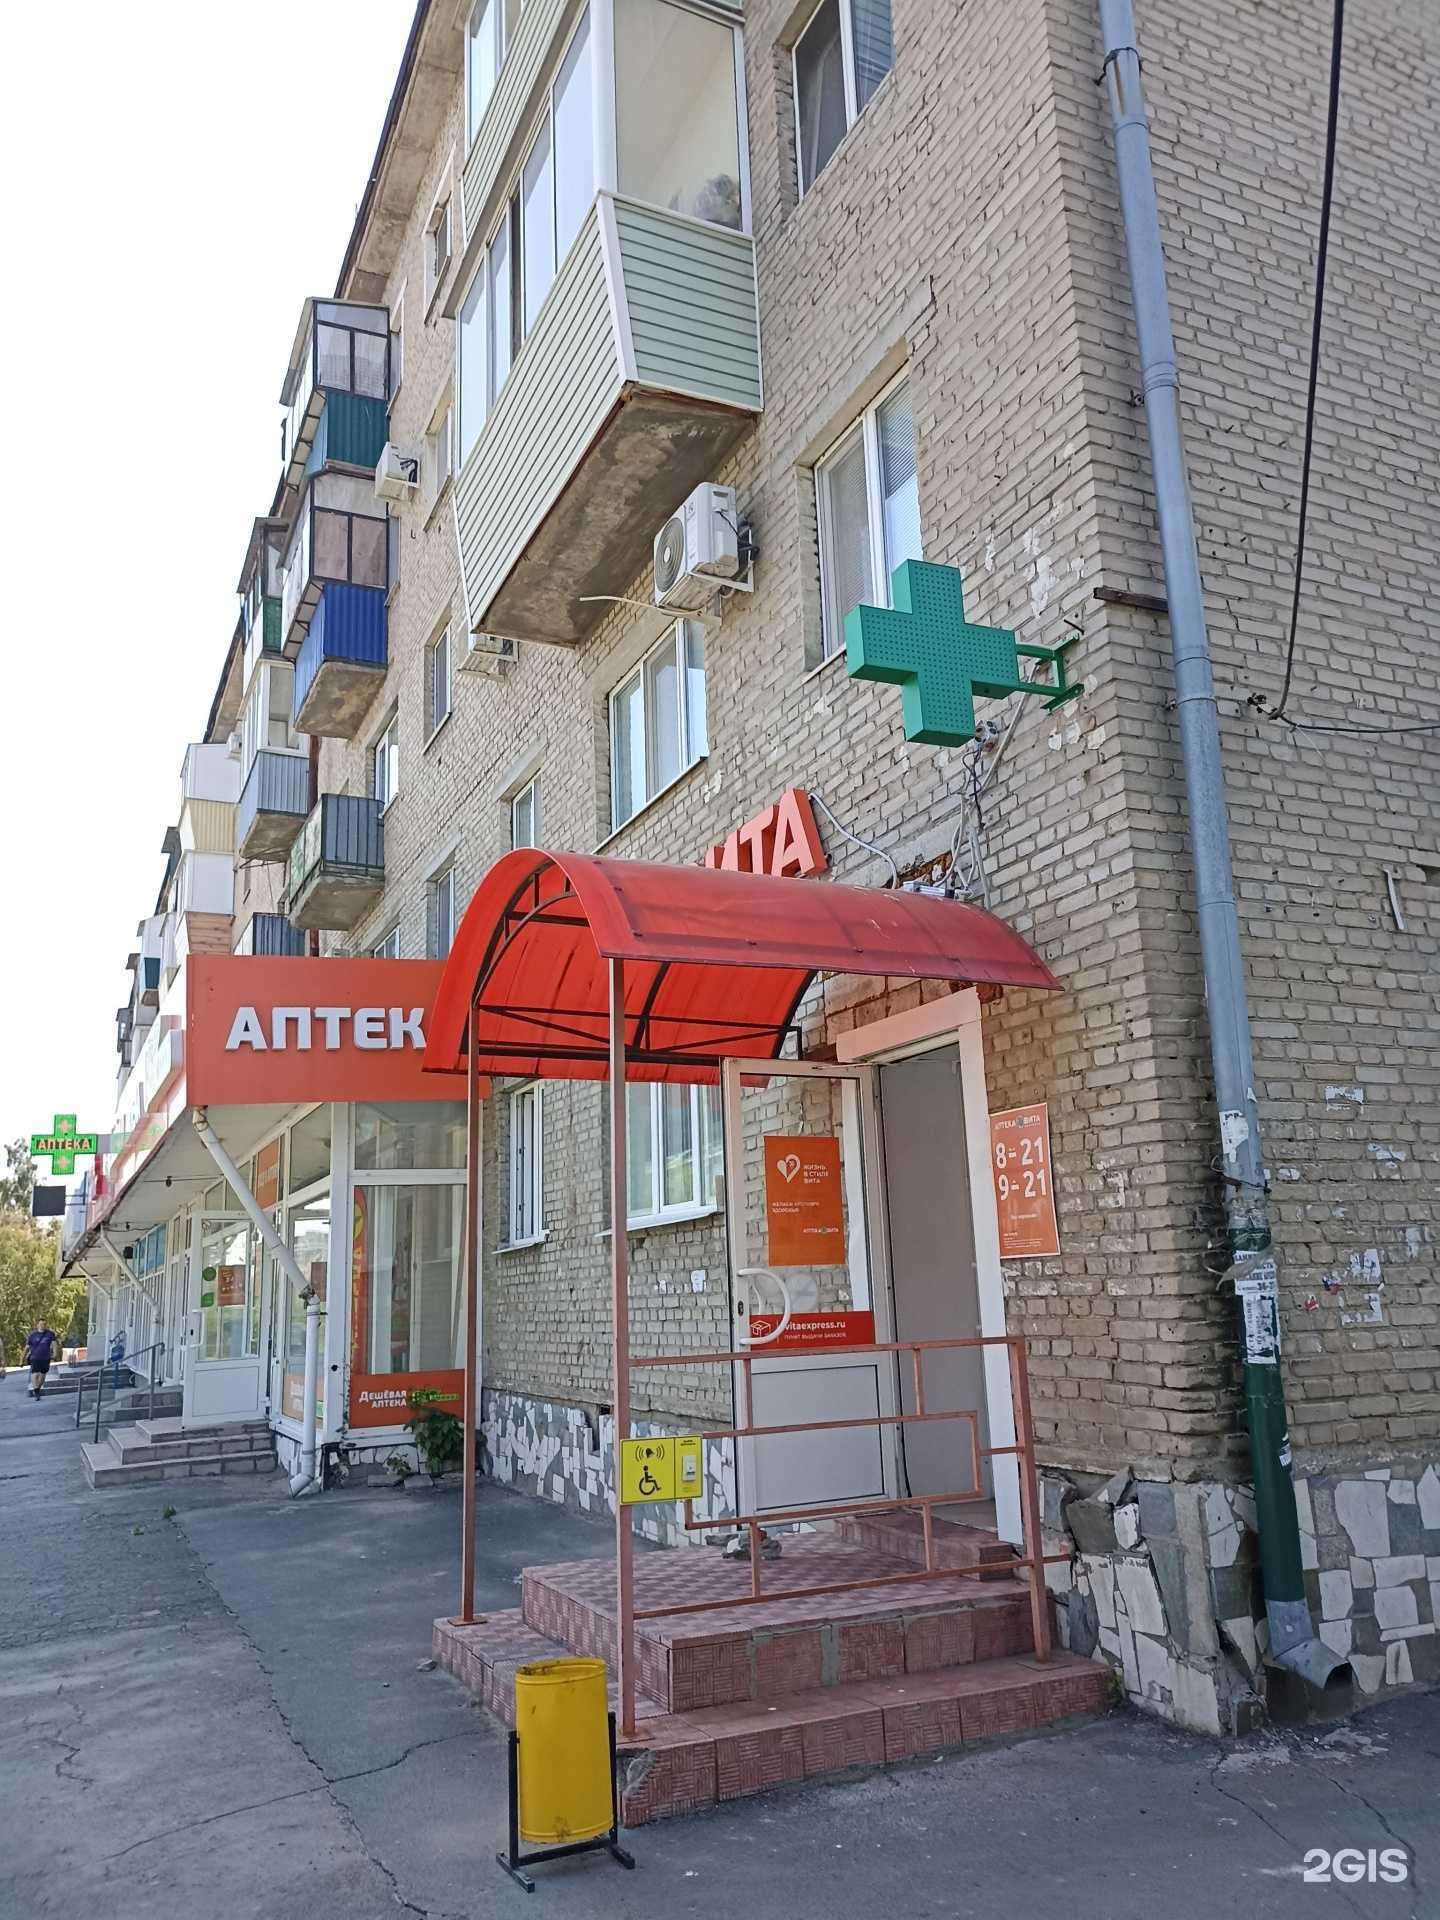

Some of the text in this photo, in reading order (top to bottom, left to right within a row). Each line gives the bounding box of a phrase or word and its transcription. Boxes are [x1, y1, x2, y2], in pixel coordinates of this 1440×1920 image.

[225, 1006, 427, 1051] АПТЕК
[37, 1138, 91, 1151] АПТЕКА
[784, 1320, 847, 1331] vitaexpress.ru
[371, 1398, 407, 1409] АПТЕКА
